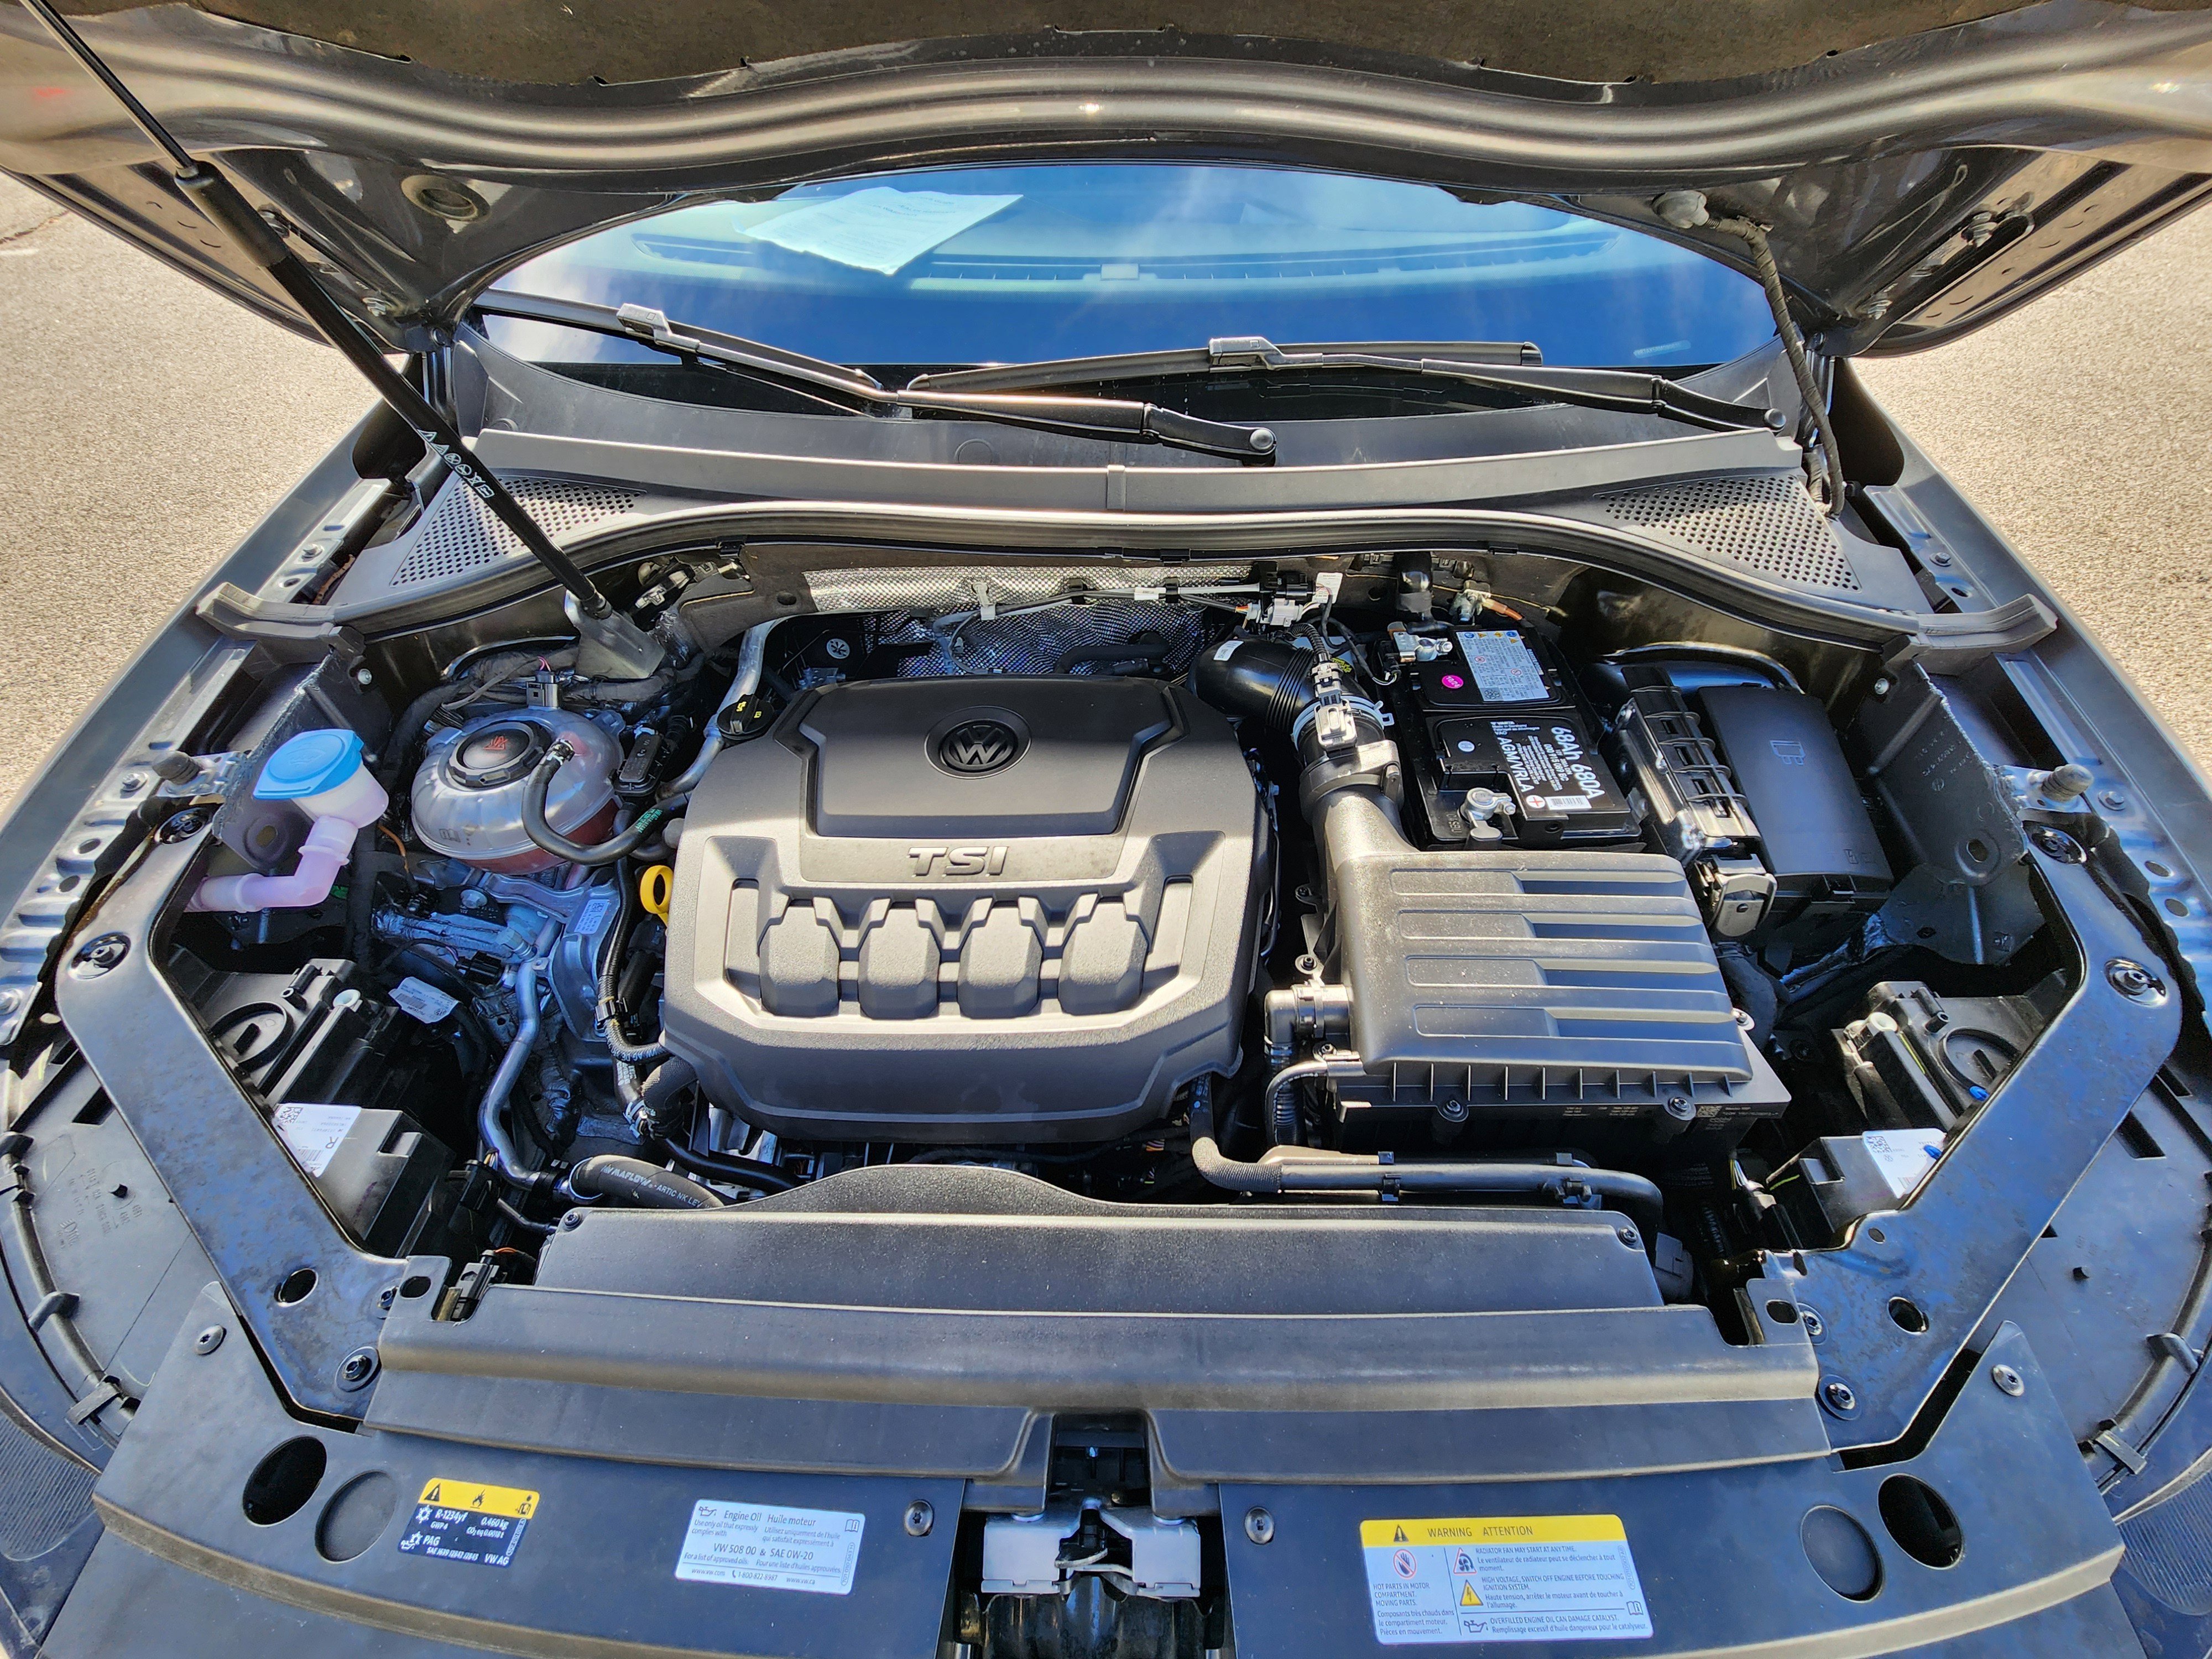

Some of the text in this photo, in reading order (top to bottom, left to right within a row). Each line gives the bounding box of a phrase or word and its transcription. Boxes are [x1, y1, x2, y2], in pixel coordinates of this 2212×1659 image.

[1497, 737, 1535, 792] AGM/VRLA
[1548, 753, 1559, 763] 915
[1557, 773, 1569, 781] BC
[1551, 727, 1605, 799] 68Ah 680A
[908, 846, 1009, 877] TSI
[676, 1192, 688, 1202] NK
[435, 1509, 469, 1524] R-1234yf
[724, 1510, 761, 1521] Engine Oil
[767, 1514, 816, 1526] Huile moteur
[430, 1521, 444, 1529] GWP
[499, 1519, 510, 1530] kg
[705, 1520, 716, 1528] only
[734, 1523, 759, 1533] expressly
[691, 1528, 714, 1536] complies
[784, 1528, 816, 1537] uniquement
[1427, 1525, 1534, 1538] WARNING ATTENTION
[422, 1535, 441, 1546] PAG
[771, 1535, 792, 1543] satisfait
[792, 1537, 830, 1547] expressément
[426, 1547, 438, 1555] SAE
[484, 1553, 497, 1563] VW
[497, 1556, 510, 1566] AG
[713, 1542, 729, 1553] VW
[728, 1545, 744, 1554] 508
[745, 1546, 757, 1555] 00
[770, 1548, 786, 1558] SAE
[786, 1550, 814, 1560] 0W-20
[713, 1556, 738, 1564] approved
[1548, 1556, 1561, 1564] peut
[786, 1577, 815, 1585] www.vw.ca
[1492, 1625, 1527, 1634] Remplissage
[1619, 1623, 1648, 1631] catalyseur.
